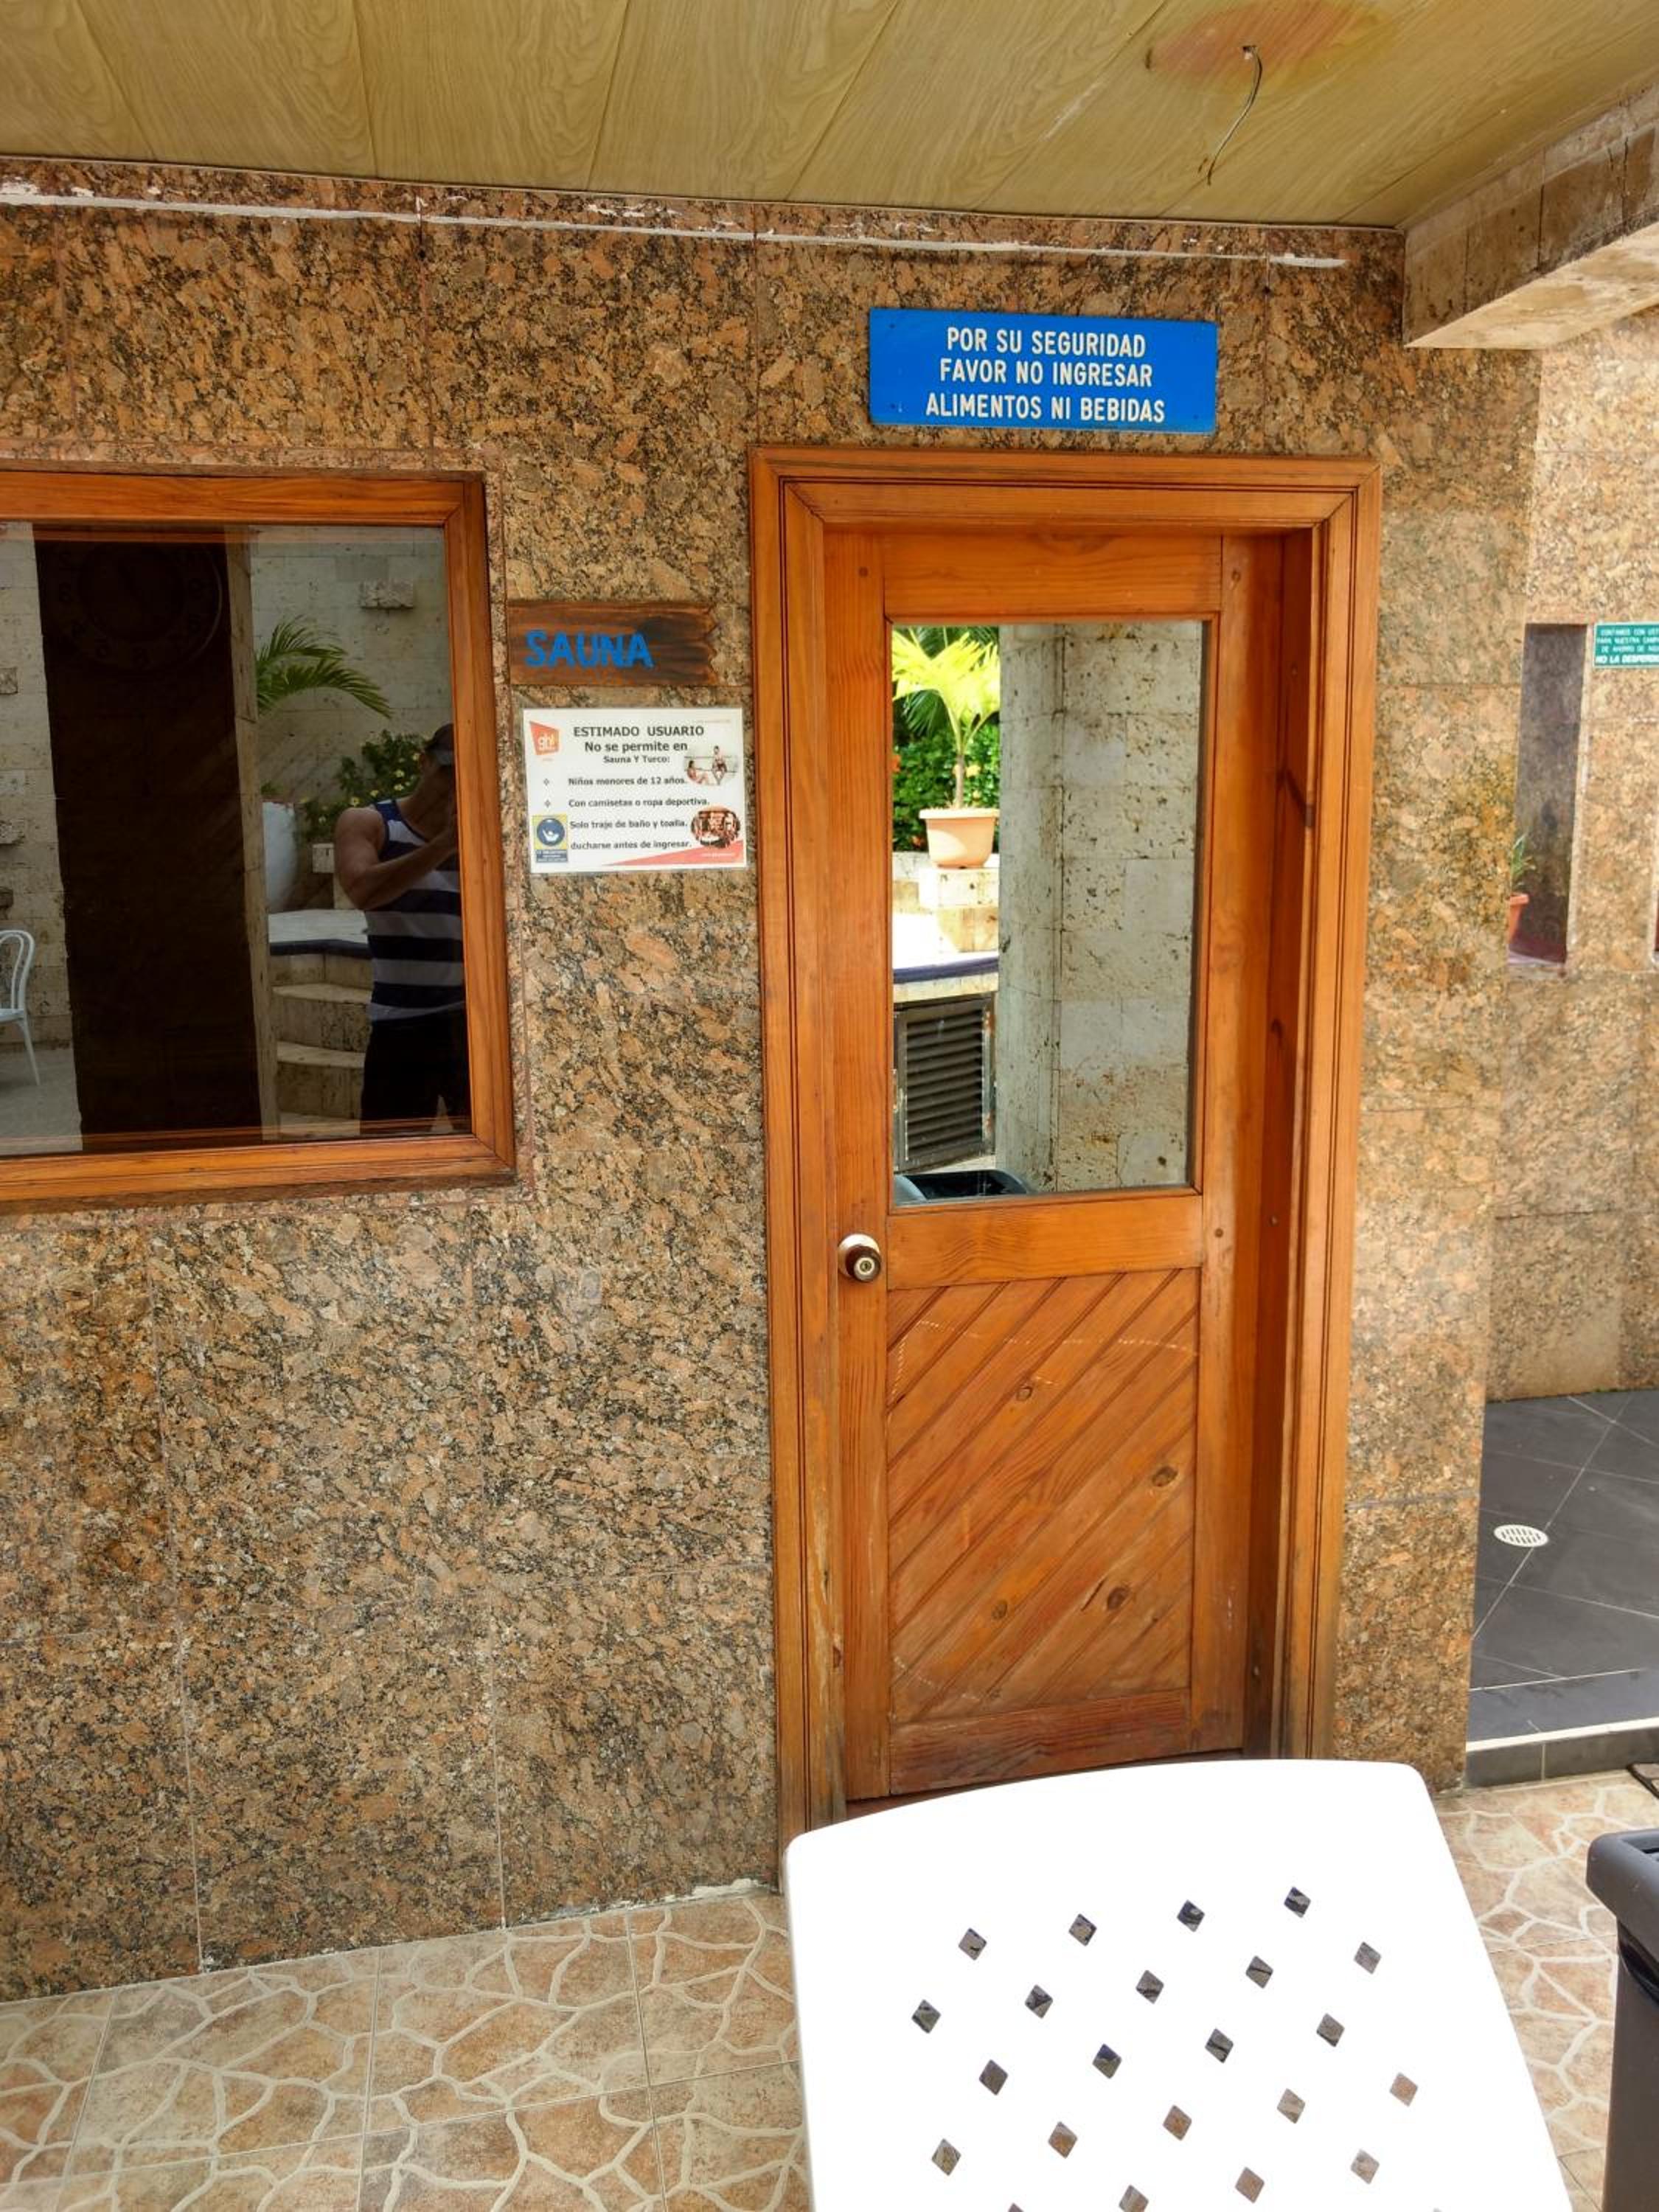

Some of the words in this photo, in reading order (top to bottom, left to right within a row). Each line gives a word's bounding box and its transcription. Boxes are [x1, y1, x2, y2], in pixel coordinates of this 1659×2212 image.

[947, 327, 987, 352] POR
[996, 329, 1022, 353] SU
[1032, 330, 1146, 358] SEGURIDAD
[940, 358, 1006, 383] FAVOR
[1016, 361, 1043, 384] NO
[1053, 363, 1152, 387] INGRESAR
[925, 393, 1042, 420] ALIMENTOS
[1051, 397, 1071, 420] NI
[1080, 397, 1165, 423] BEBIDAS
[524, 630, 654, 669] SAUNA
[1596, 654, 1607, 664] NO
[1610, 654, 1620, 664] LA
[574, 726, 639, 737] ESTIMADO
[647, 726, 704, 736] USUARIO
[585, 742, 601, 752] No
[605, 743, 618, 751] se
[622, 741, 669, 754] permite
[673, 742, 687, 751] en
[568, 776, 594, 785] Niños
[637, 776, 647, 785] de
[568, 799, 586, 807] Con
[588, 799, 633, 807] camisetas
[643, 800, 663, 808] ropa
[666, 797, 709, 807] deportiva.
[570, 821, 588, 829] Solo
[591, 820, 613, 830] traje
[615, 820, 626, 828] de
[629, 819, 650, 828] baño
[571, 841, 611, 850] ducharse
[613, 841, 637, 849] antes
[639, 841, 651, 849] de
[653, 840, 692, 849] ingresar.
